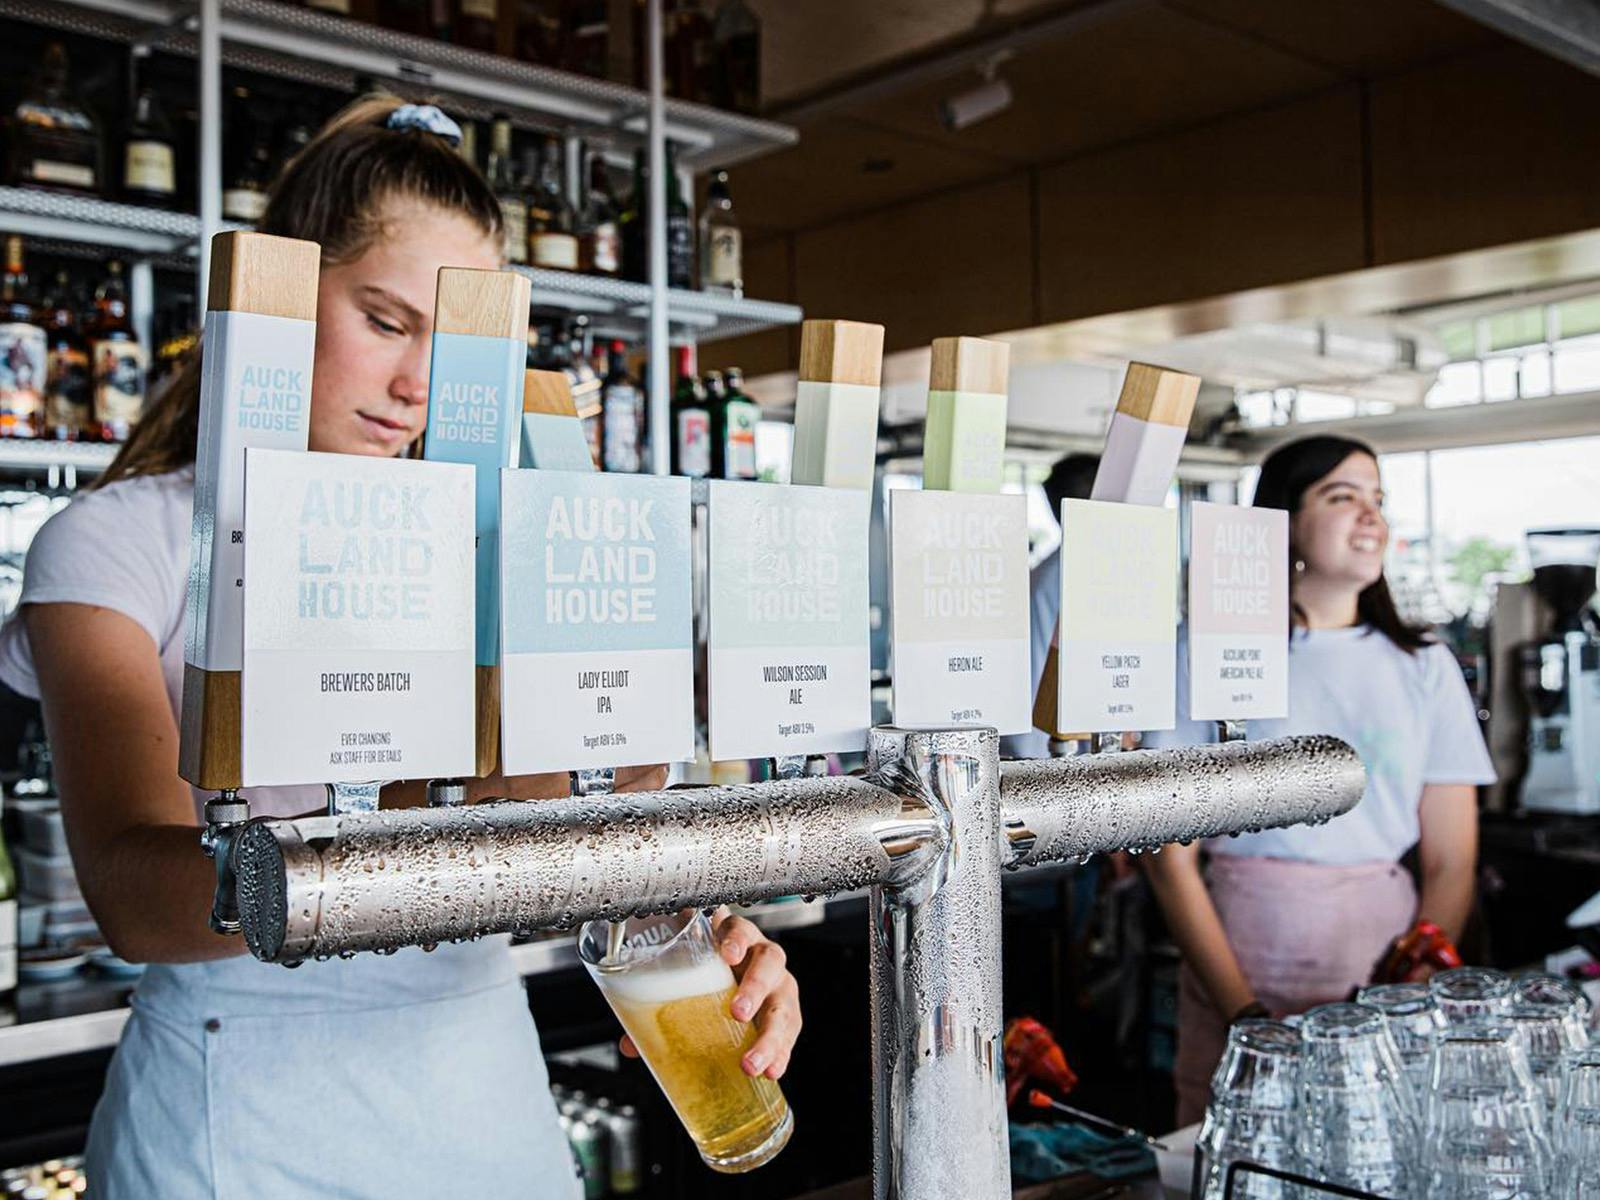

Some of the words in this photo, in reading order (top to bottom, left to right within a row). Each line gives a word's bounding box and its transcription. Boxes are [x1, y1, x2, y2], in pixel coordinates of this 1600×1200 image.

[240, 366, 302, 391] AUCK
[240, 388, 302, 412] LAND
[438, 382, 498, 406] AUCK
[238, 411, 301, 432] HOUSE
[438, 403, 498, 425] LAND
[436, 424, 497, 444] HOUSE
[299, 479, 433, 530] AUCK
[545, 495, 656, 541] AUCK
[924, 511, 1008, 549] AUCK
[1213, 522, 1271, 558] AUCK
[298, 532, 433, 577] LAND
[545, 543, 657, 583] LAND
[922, 552, 1006, 585] LAND
[1212, 558, 1270, 586] LAND
[298, 581, 432, 620] HOUSE
[546, 587, 657, 624] HOUSE
[923, 588, 1007, 617] HOUSE
[1212, 588, 1271, 615] HOUSE
[763, 665, 794, 682] WILSON
[795, 664, 827, 681] SESSION
[948, 657, 971, 672] HERON
[971, 656, 983, 671] ALE
[1102, 655, 1122, 669] YELLOW
[321, 673, 374, 692] BREWERS
[377, 672, 411, 691] BATCH
[578, 671, 600, 689] LADY
[602, 670, 629, 688] ELLIOT
[1112, 674, 1130, 688] LAGER
[597, 696, 612, 713] IPA
[789, 688, 803, 704] ALE
[341, 733, 358, 746] EVER
[358, 732, 391, 745] CHANGING
[583, 735, 599, 749] Target
[329, 751, 344, 765] ASK
[344, 751, 363, 764] STAFF
[363, 750, 377, 763] FOR
[377, 749, 402, 762] DETAILS
